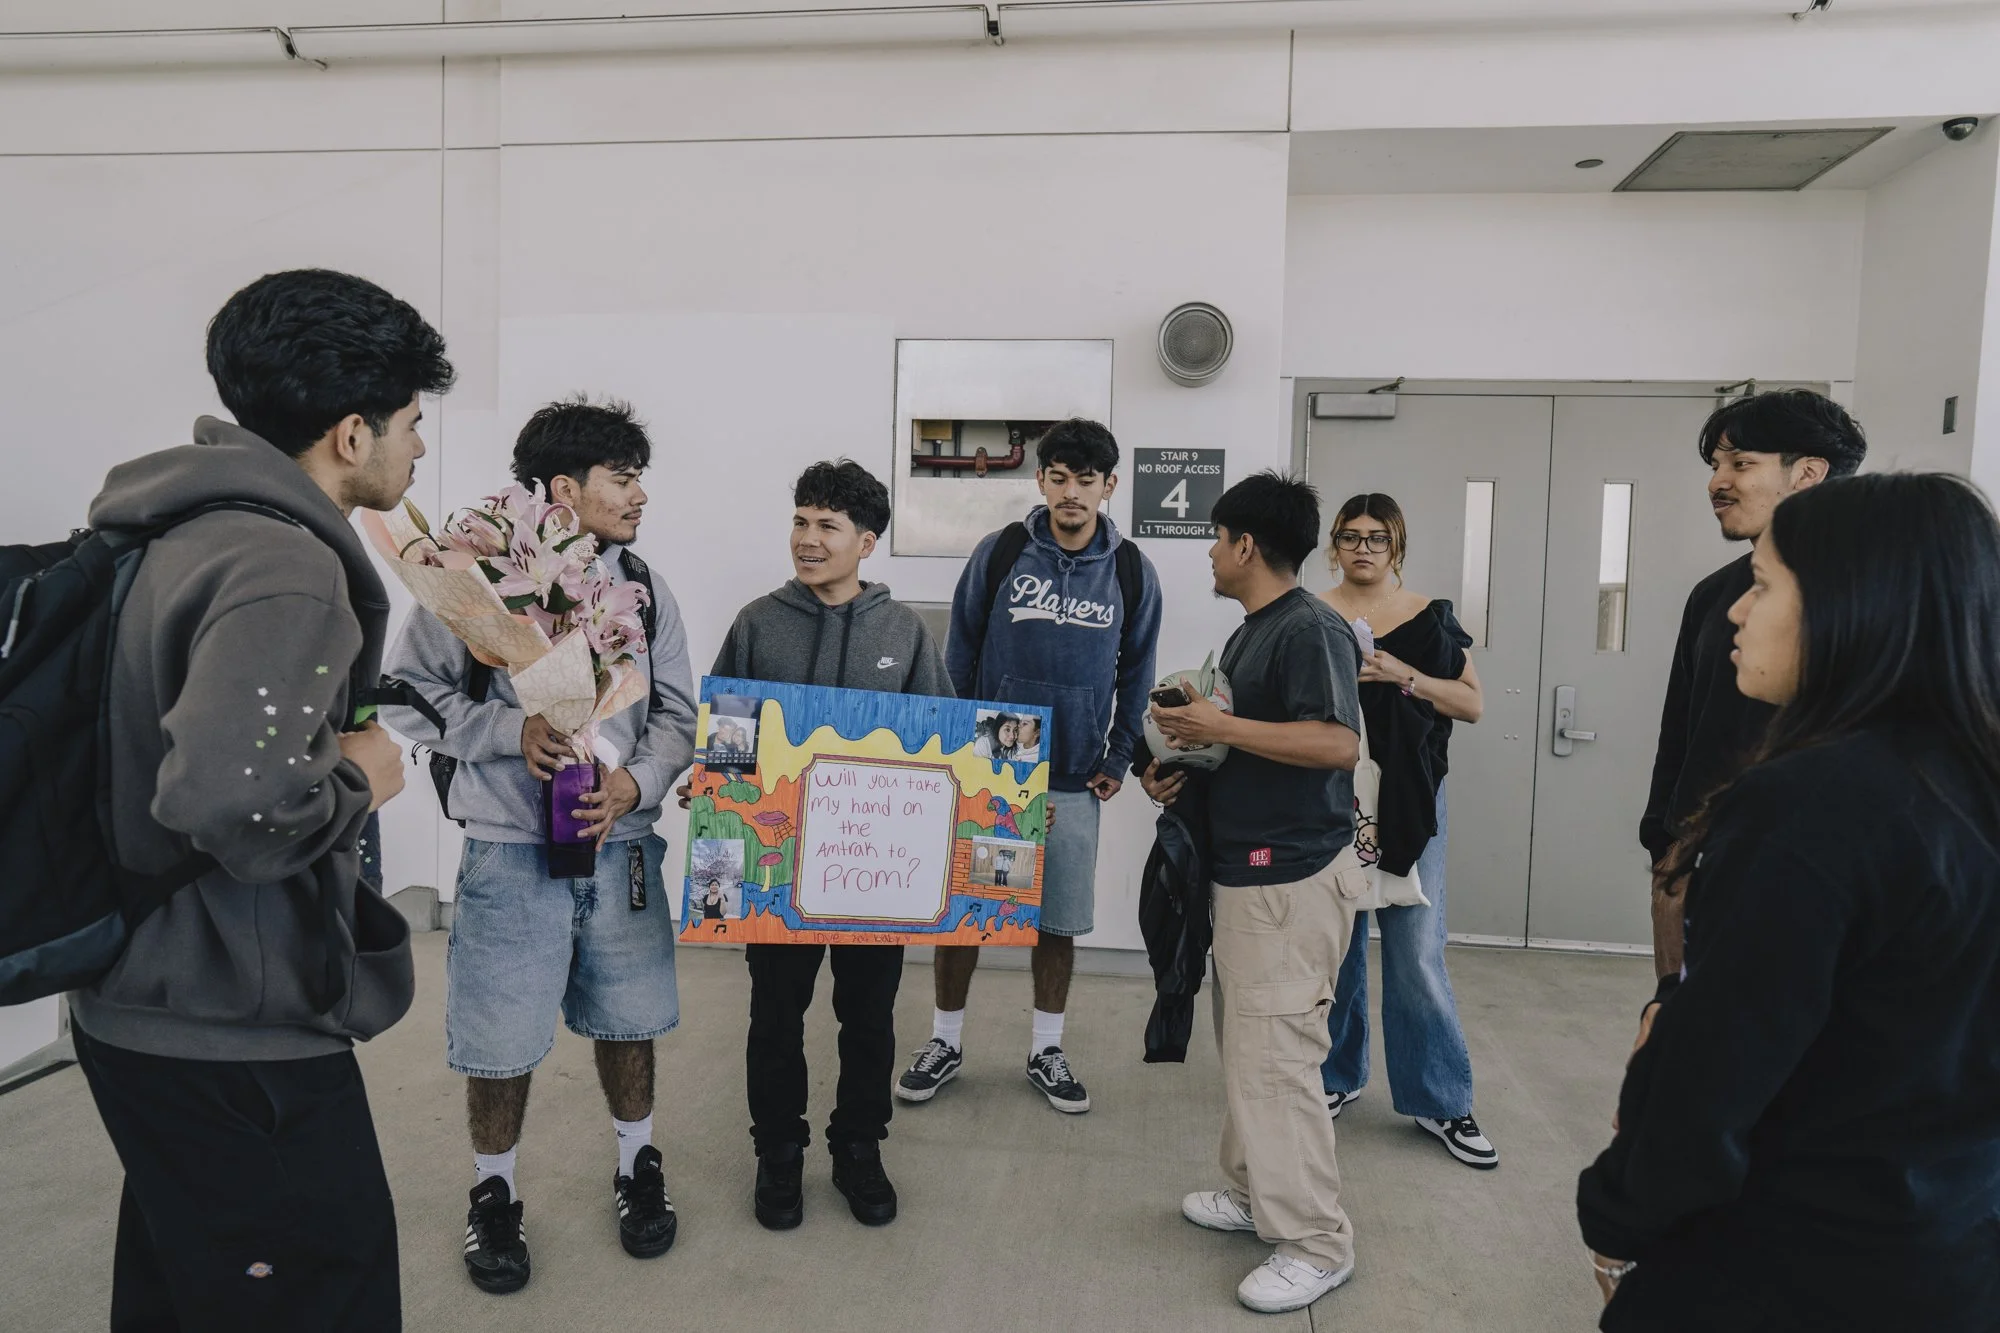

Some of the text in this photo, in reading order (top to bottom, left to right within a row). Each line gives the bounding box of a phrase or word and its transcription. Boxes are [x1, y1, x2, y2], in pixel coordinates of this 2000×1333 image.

[1160, 451, 1199, 461] STAIR 9
[1138, 463, 1221, 475] NO ROOF ACCESS
[1160, 478, 1190, 519] 4
[1139, 524, 1215, 536] L1 THROUGH 4
[1010, 574, 1115, 627] Players
[815, 768, 941, 794] Will you take
[851, 794, 891, 816] hand
[903, 801, 923, 815] on
[838, 820, 871, 837] the
[816, 840, 907, 858] Amtrak to
[823, 857, 921, 893] Prom?
[791, 930, 803, 943] I
[813, 932, 840, 943] love
